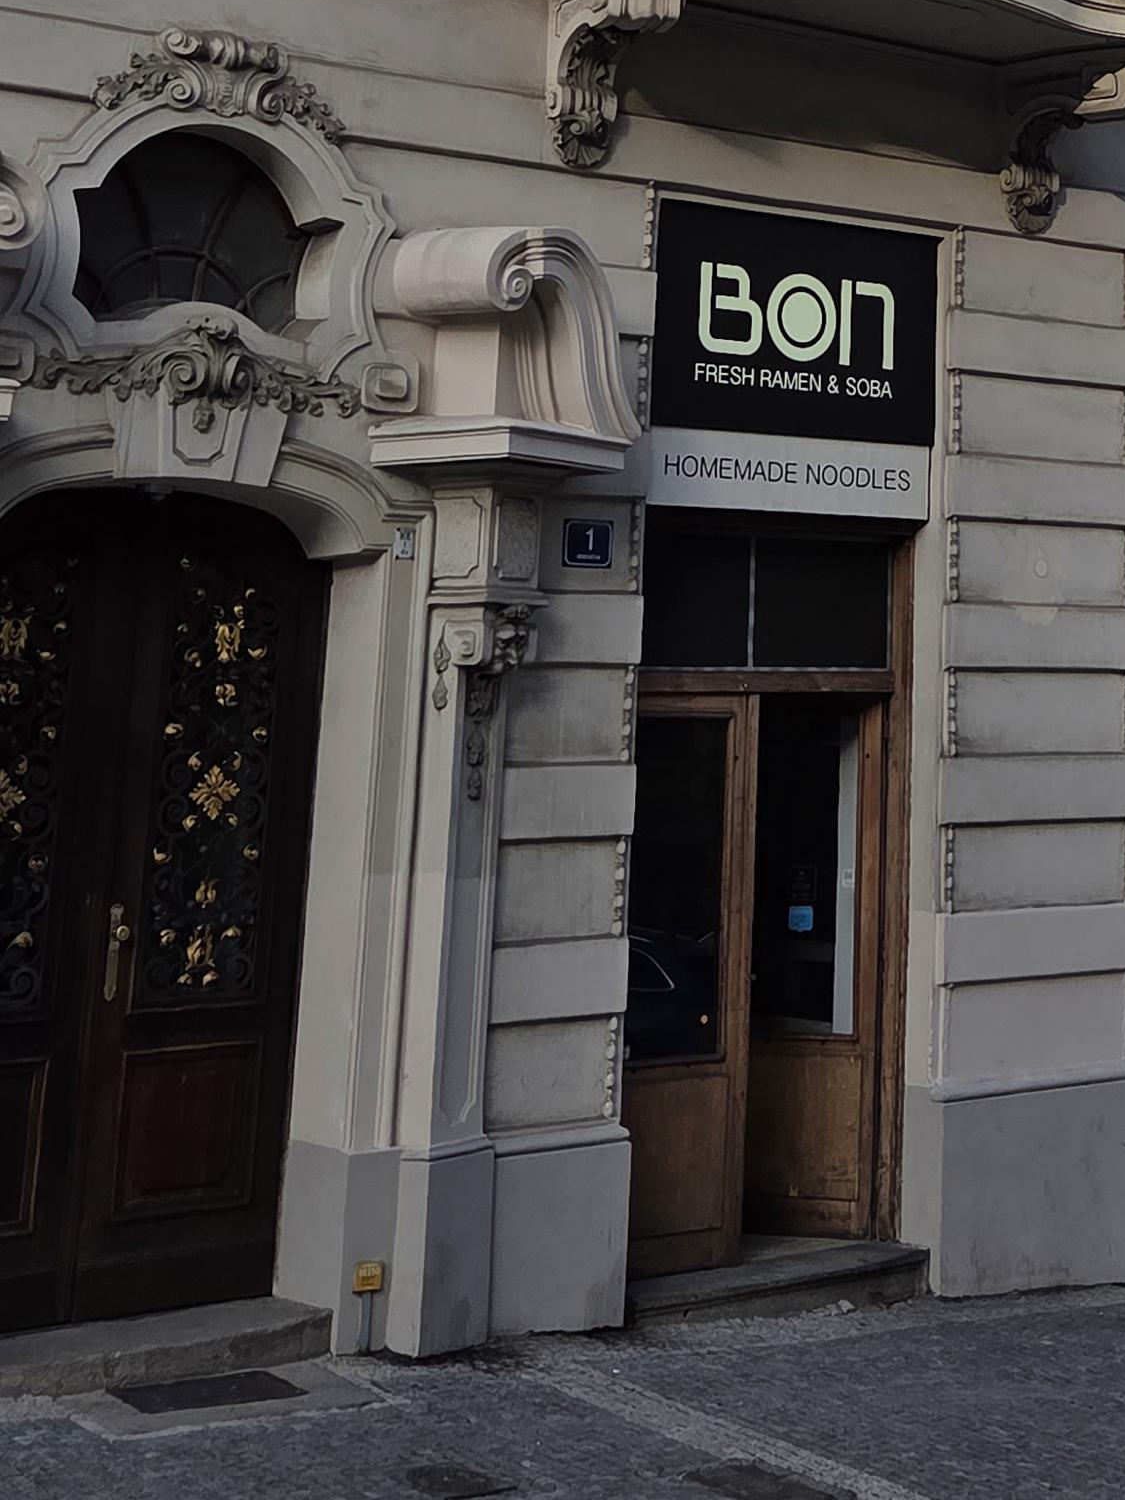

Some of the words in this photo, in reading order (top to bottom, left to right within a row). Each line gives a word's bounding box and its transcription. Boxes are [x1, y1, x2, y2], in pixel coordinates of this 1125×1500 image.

[694, 363, 755, 387] FRESH
[759, 369, 822, 393] RAMEN
[827, 376, 840, 395] &
[845, 377, 893, 399] SOBA
[663, 453, 798, 484] HOMEMADE
[805, 464, 911, 491] NOODLES
[585, 527, 594, 551] 1
